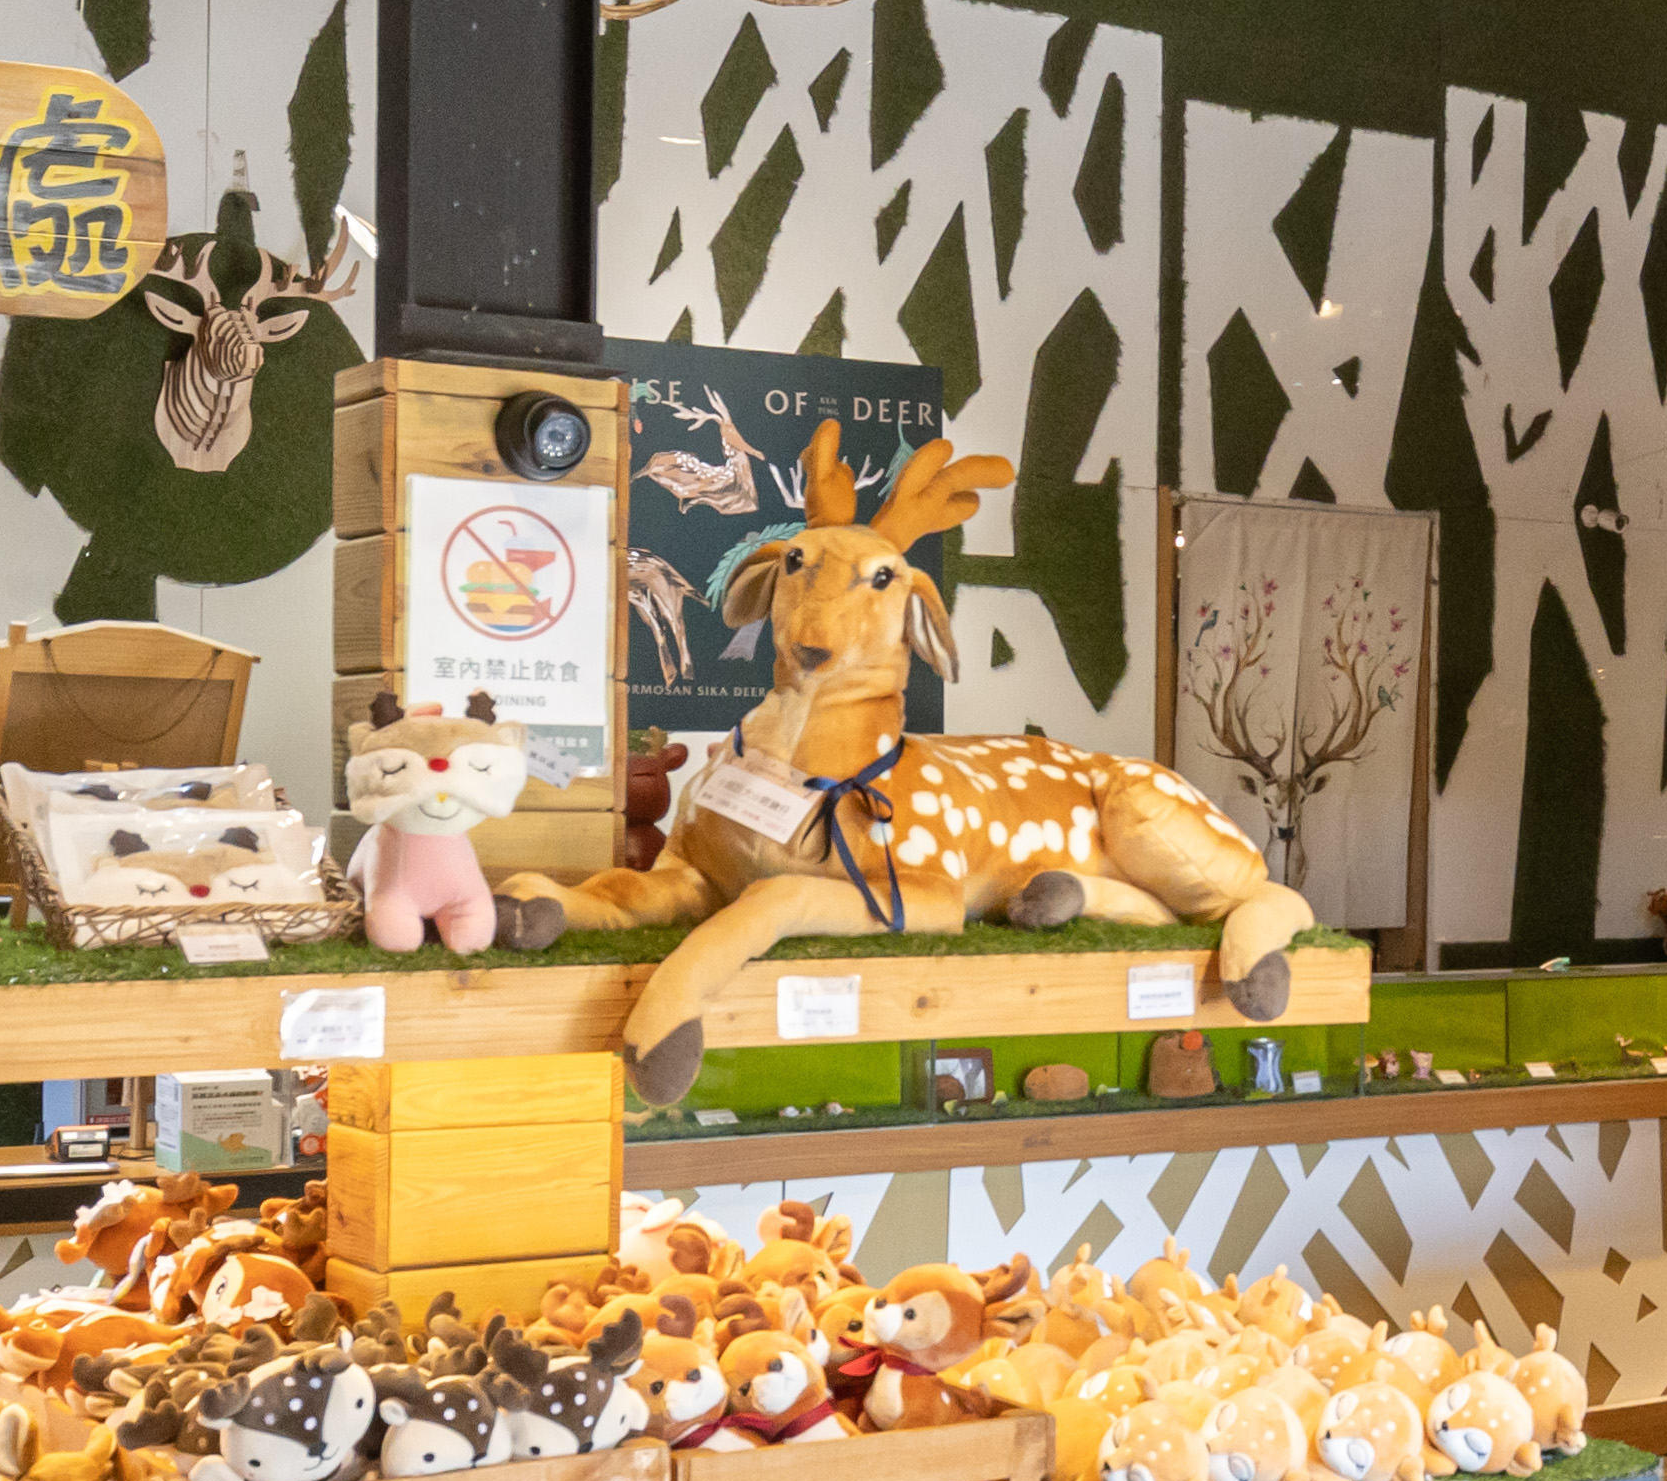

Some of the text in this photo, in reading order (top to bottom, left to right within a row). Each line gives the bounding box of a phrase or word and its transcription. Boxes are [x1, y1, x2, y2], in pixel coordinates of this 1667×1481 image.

[764, 389, 808, 416] OF
[852, 396, 935, 427] DEER
[433, 656, 581, 683] 室內禁止飲食
[697, 685, 729, 697] SIKA
[733, 686, 766, 698] DEER
